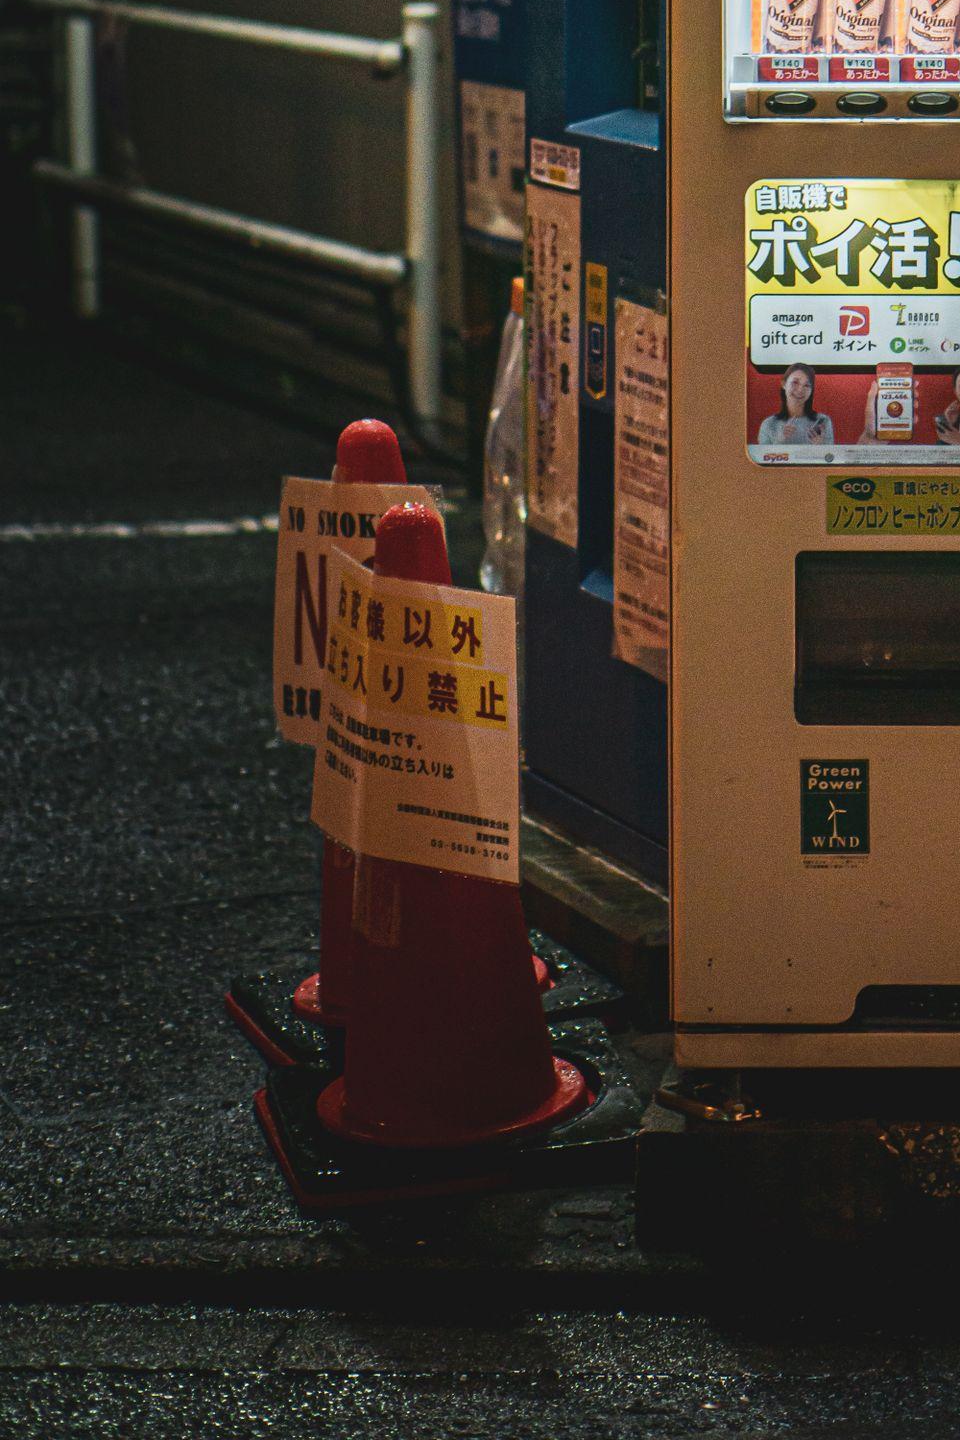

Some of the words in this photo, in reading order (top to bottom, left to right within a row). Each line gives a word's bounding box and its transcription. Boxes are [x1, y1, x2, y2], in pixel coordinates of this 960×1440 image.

[768, 5, 814, 31] Original
[836, 5, 881, 31] Original
[910, 5, 957, 31] Original
[775, 60, 800, 68] ¥140
[848, 60, 872, 68] ¥140
[917, 60, 942, 68] ¥140
[756, 184, 847, 213] 自販機で
[772, 312, 814, 323] amazon
[908, 312, 940, 323] nanaco
[762, 331, 787, 348] gift
[792, 330, 823, 346] card
[833, 340, 877, 352] ポイント
[842, 482, 871, 493] eco
[339, 582, 481, 657] お客様以外
[328, 635, 507, 722] 立ち入り禁止
[809, 764, 861, 777] Green
[808, 778, 863, 790] Power
[812, 836, 861, 848] WIND
